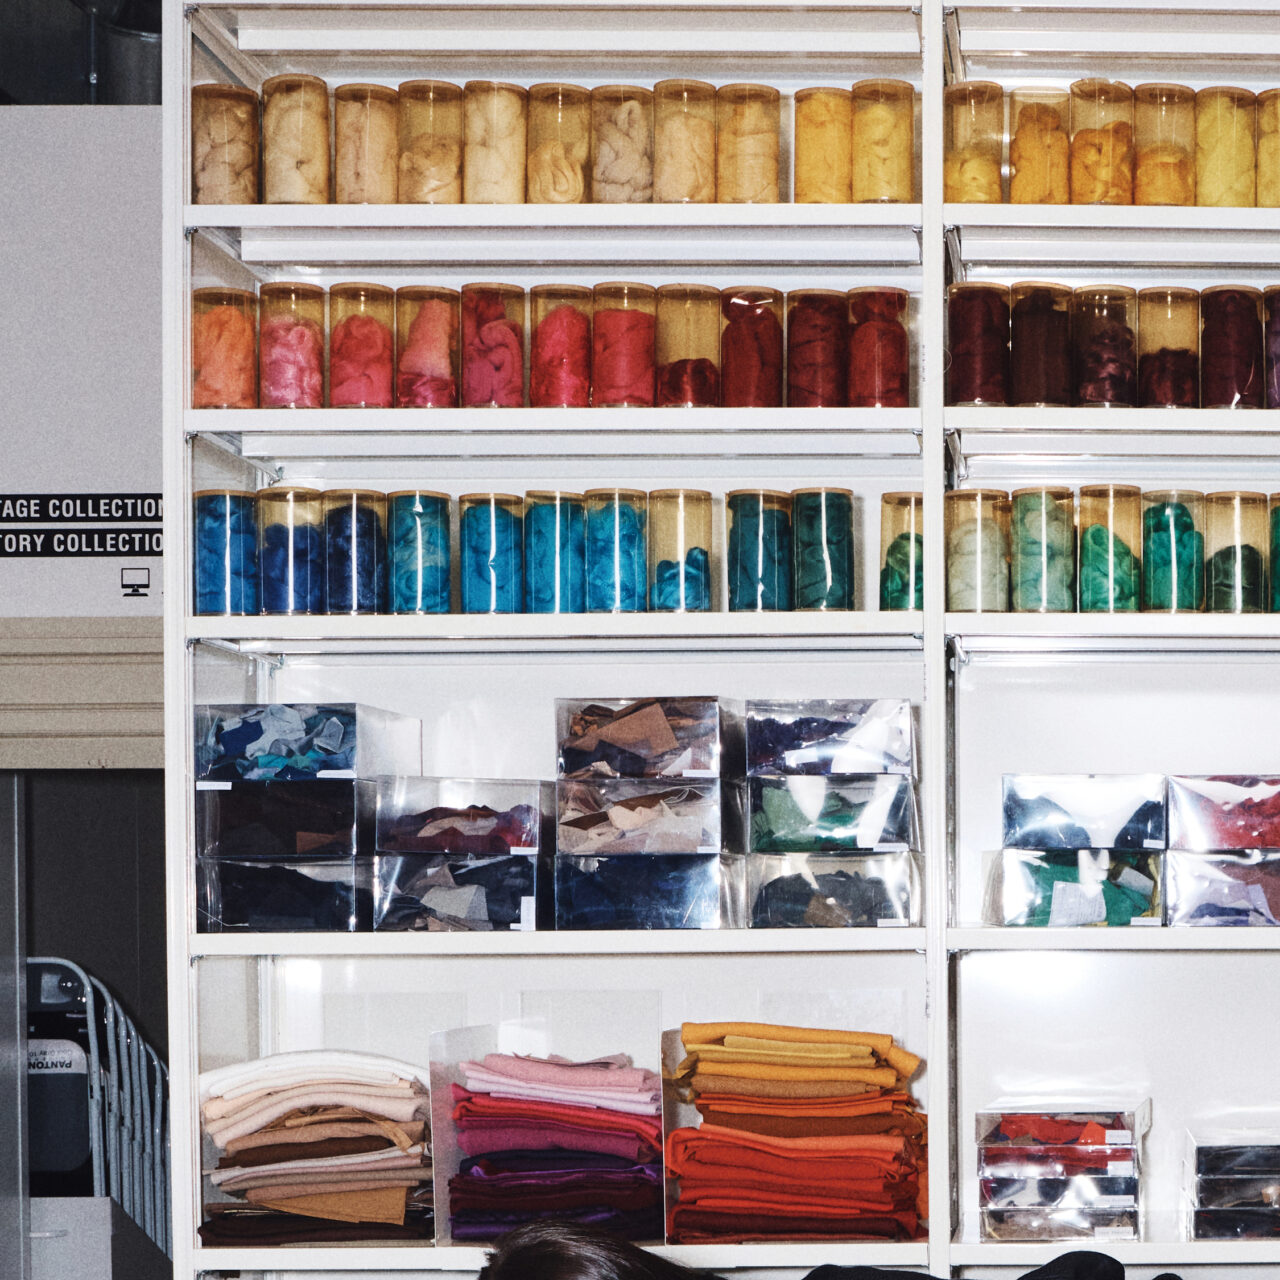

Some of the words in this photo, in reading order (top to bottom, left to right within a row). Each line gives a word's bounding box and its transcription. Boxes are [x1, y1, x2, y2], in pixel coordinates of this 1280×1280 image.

[0, 498, 40, 518] AGE
[0, 533, 45, 552] ORY
[53, 533, 163, 552] COLLECTIO
[28, 1061, 72, 1070] PANTON
